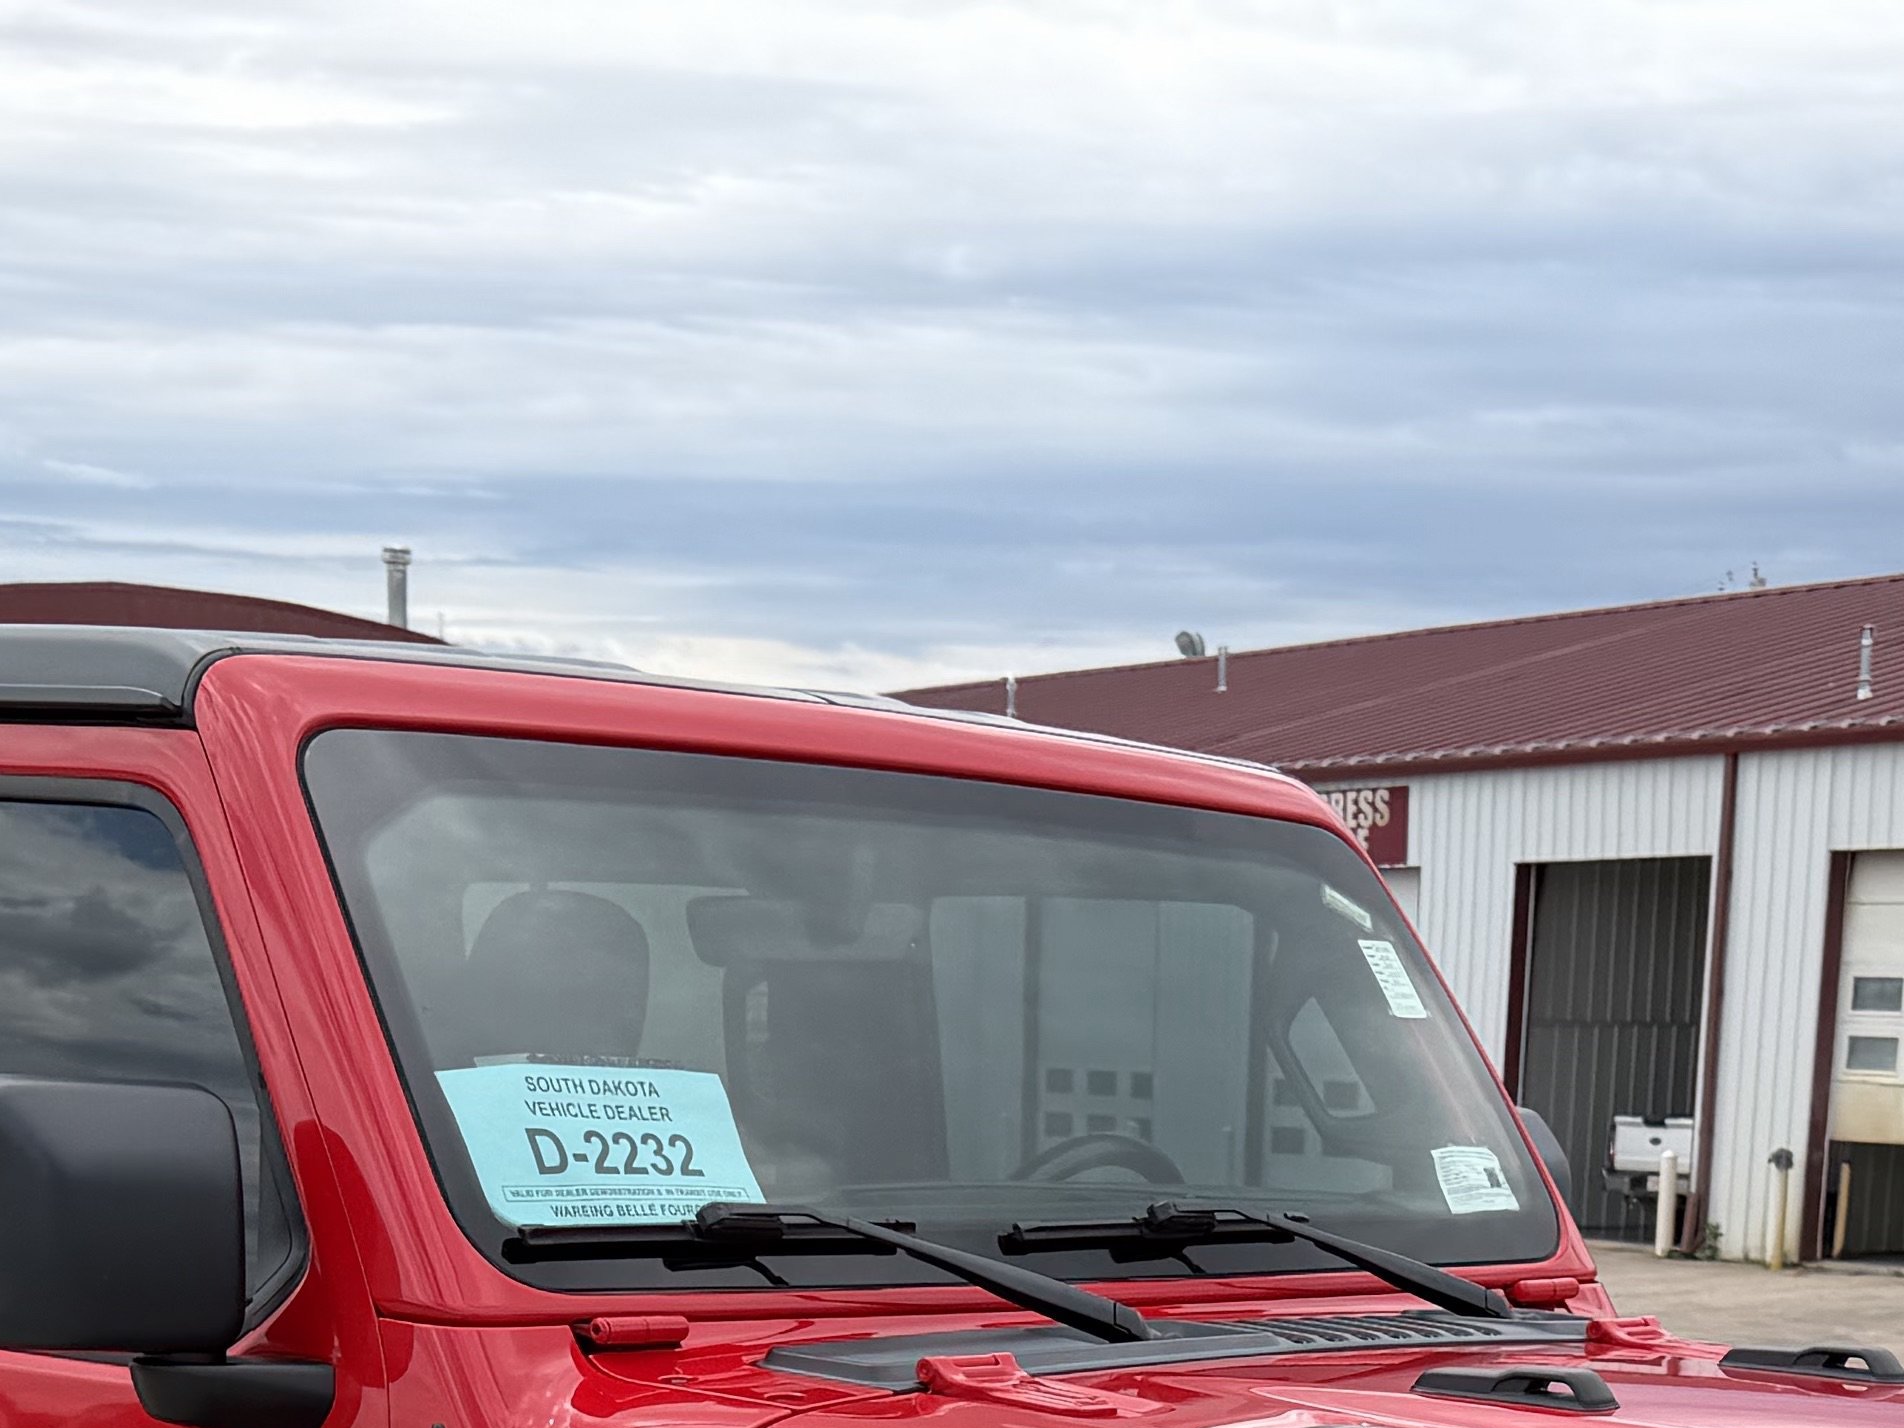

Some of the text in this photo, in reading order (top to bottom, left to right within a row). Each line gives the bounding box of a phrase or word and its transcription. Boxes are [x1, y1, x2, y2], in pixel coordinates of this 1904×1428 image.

[524, 1075, 660, 1099] SOUTH DAKOTA
[524, 1100, 673, 1122] VEHICLE DEALER
[524, 1127, 705, 1178] D-2232
[549, 1204, 614, 1218] WAREING
[616, 1204, 658, 1217] BELLE
